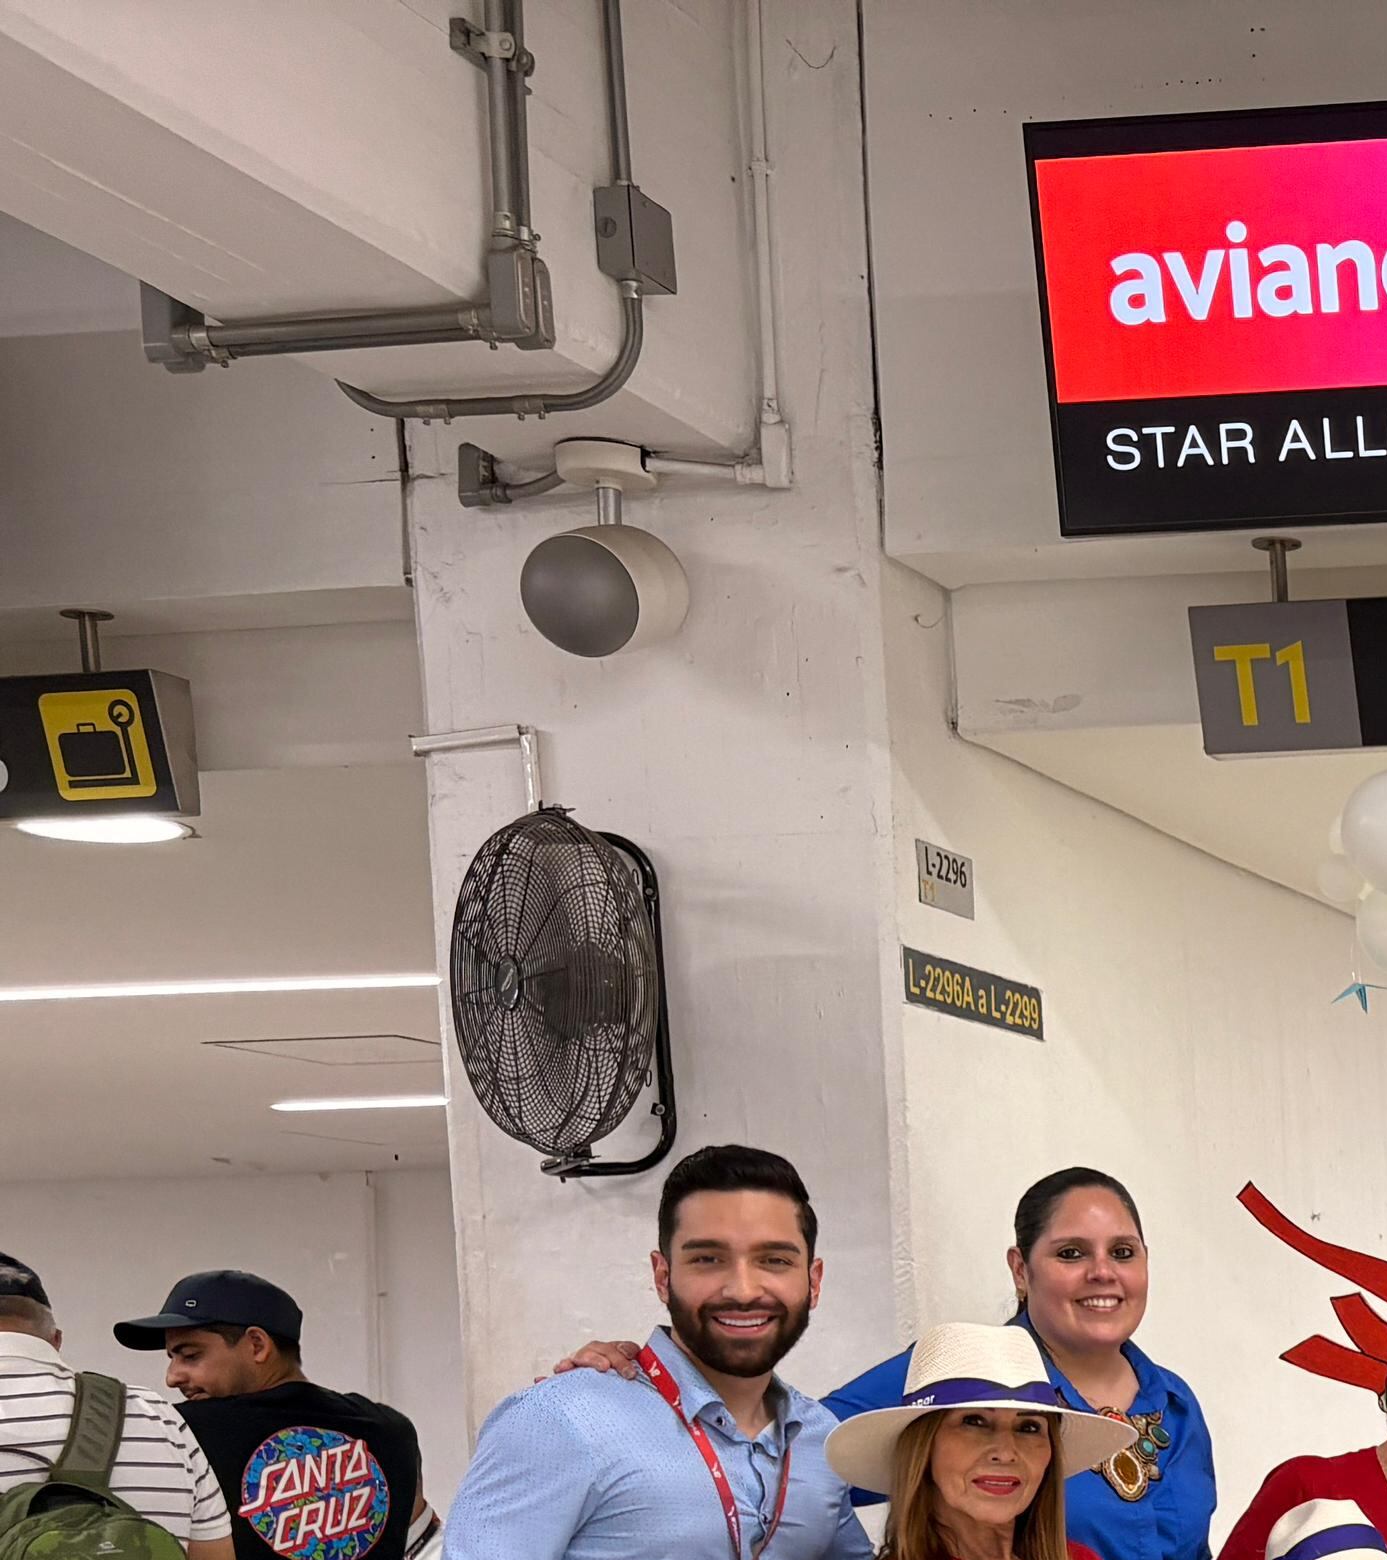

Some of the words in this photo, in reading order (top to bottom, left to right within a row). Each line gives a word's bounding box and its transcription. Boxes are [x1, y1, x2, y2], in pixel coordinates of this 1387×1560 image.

[1105, 420, 1256, 472] STAR
[1213, 639, 1310, 727] T1
[922, 879, 936, 902] T1
[924, 846, 967, 888] L-2296
[908, 958, 975, 1010] L-2296A
[978, 988, 987, 1014] a
[991, 985, 1039, 1030] L-2299
[238, 1439, 369, 1514] SANTA
[273, 1486, 371, 1552] CRUZ
